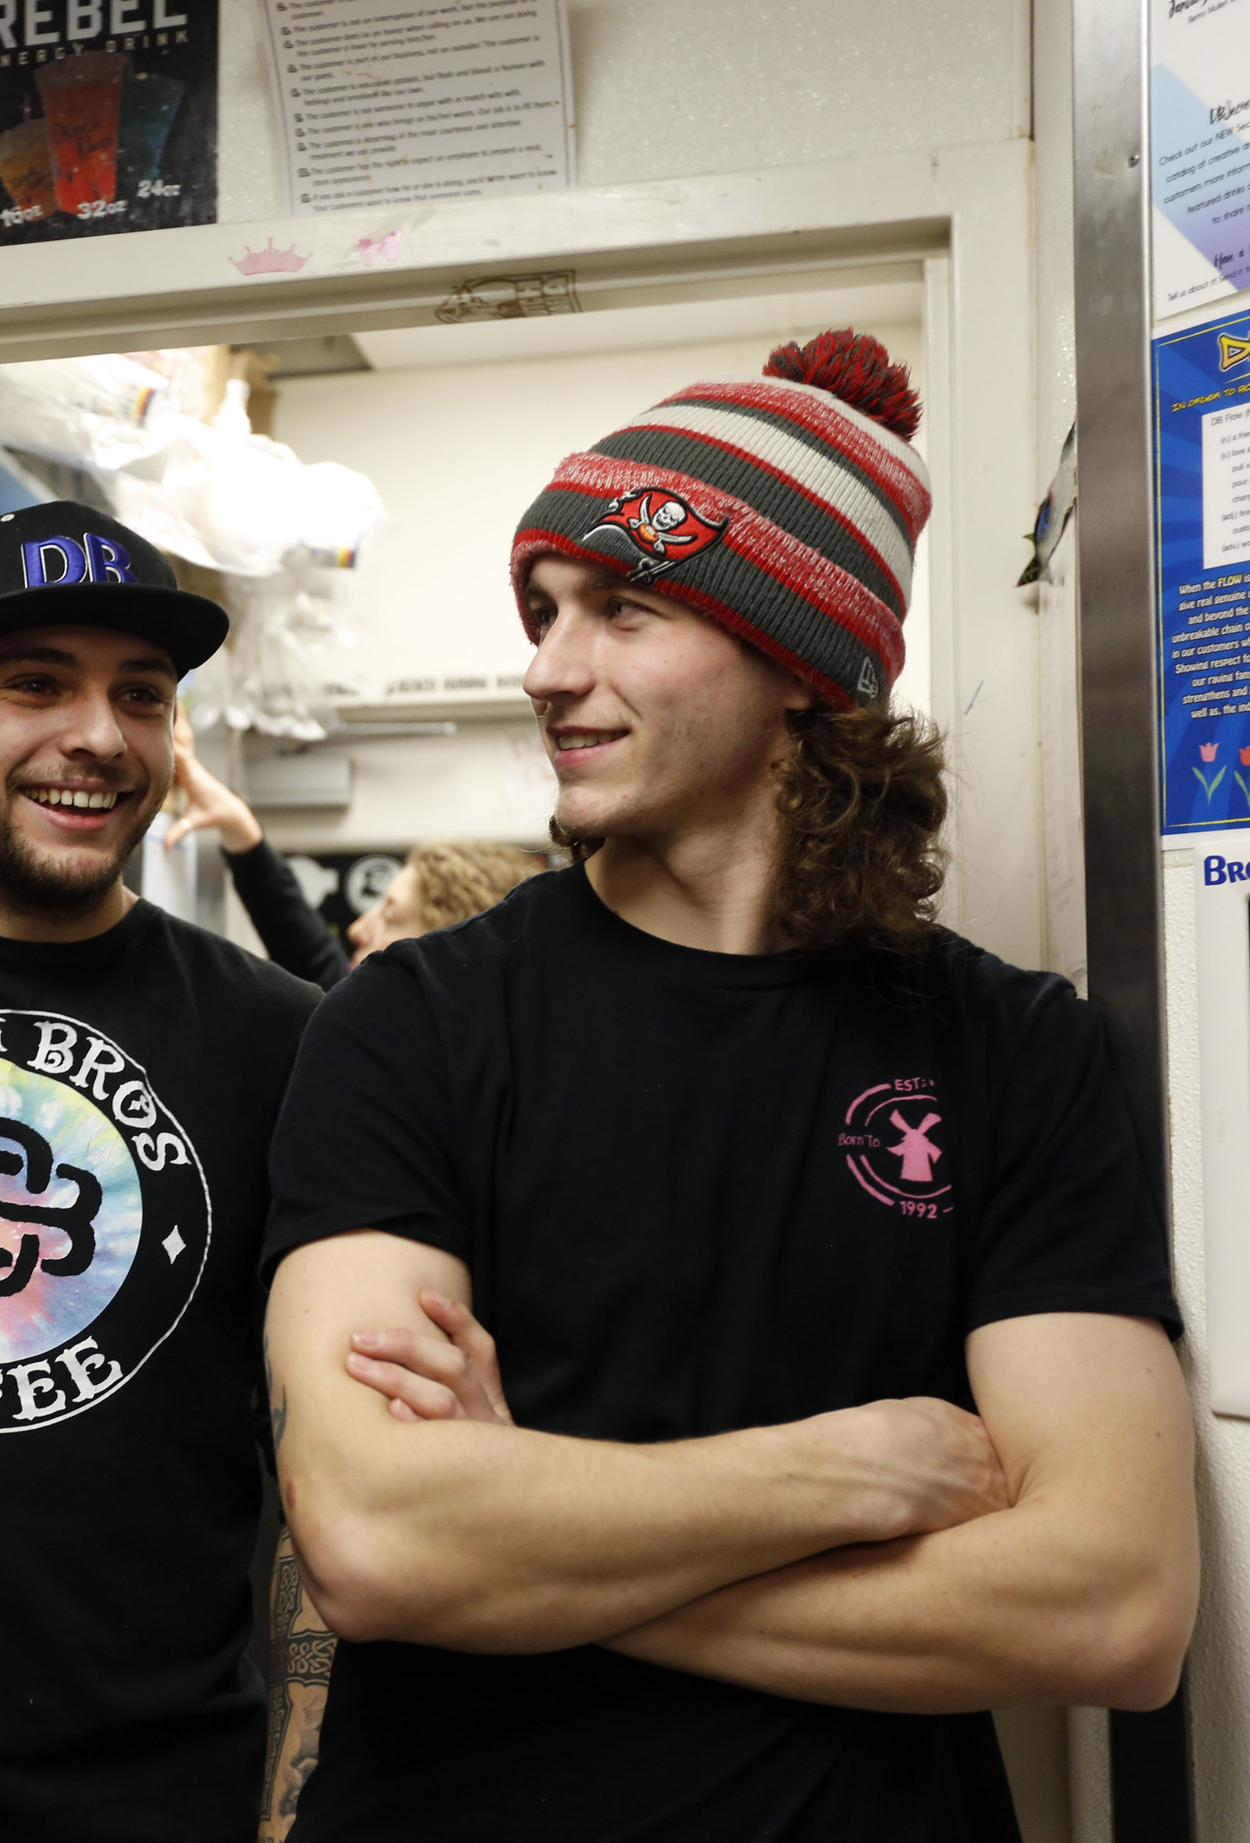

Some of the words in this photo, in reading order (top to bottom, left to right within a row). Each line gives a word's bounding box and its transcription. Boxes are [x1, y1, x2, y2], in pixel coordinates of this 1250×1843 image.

[105, 29, 190, 54] DRINK
[1159, 150, 1182, 166] Check
[1185, 144, 1197, 155] out
[1200, 137, 1213, 148] our
[1215, 127, 1235, 141] NEW
[1166, 165, 1196, 183] catalog
[1198, 160, 1205, 170] of
[1208, 145, 1241, 165] creative
[137, 180, 181, 198] 24oz
[1163, 182, 1201, 204] customers
[1204, 173, 1224, 185] more
[1187, 195, 1221, 214] featured
[1223, 184, 1245, 199] drinks
[77, 200, 127, 220] 32oz
[1212, 216, 1221, 225] to
[1224, 207, 1244, 221] share
[1171, 401, 1186, 413] IN
[1223, 387, 1236, 397] TO
[1211, 416, 1223, 427] DB
[1225, 412, 1243, 423] Flow
[21, 532, 138, 589] DB
[1179, 583, 1201, 595] When
[1203, 579, 1216, 591] the
[1217, 574, 1243, 588] FLOW
[1197, 596, 1213, 608] real
[1214, 590, 1246, 605] genuine
[1188, 613, 1203, 625] and
[1204, 607, 1234, 623] beyond
[1235, 605, 1249, 617] the
[1171, 627, 1220, 644] unbreakable
[1221, 622, 1243, 635] chain
[1171, 649, 1180, 660] in
[1181, 647, 1196, 658] our
[1197, 639, 1240, 655] customers
[1175, 659, 1209, 674] Showing
[1210, 653, 1241, 669] respect
[1192, 676, 1206, 688] our
[1207, 670, 1234, 686] raving
[1182, 688, 1231, 705] strengthens
[1232, 686, 1248, 698] and
[1191, 707, 1208, 719] well
[1223, 703, 1237, 715] the
[1203, 855, 1250, 886] BR
[28, 1020, 192, 1172] BROS
[838, 1133, 864, 1146] Born
[864, 1134, 881, 1147] To
[900, 1201, 937, 1219] 1992
